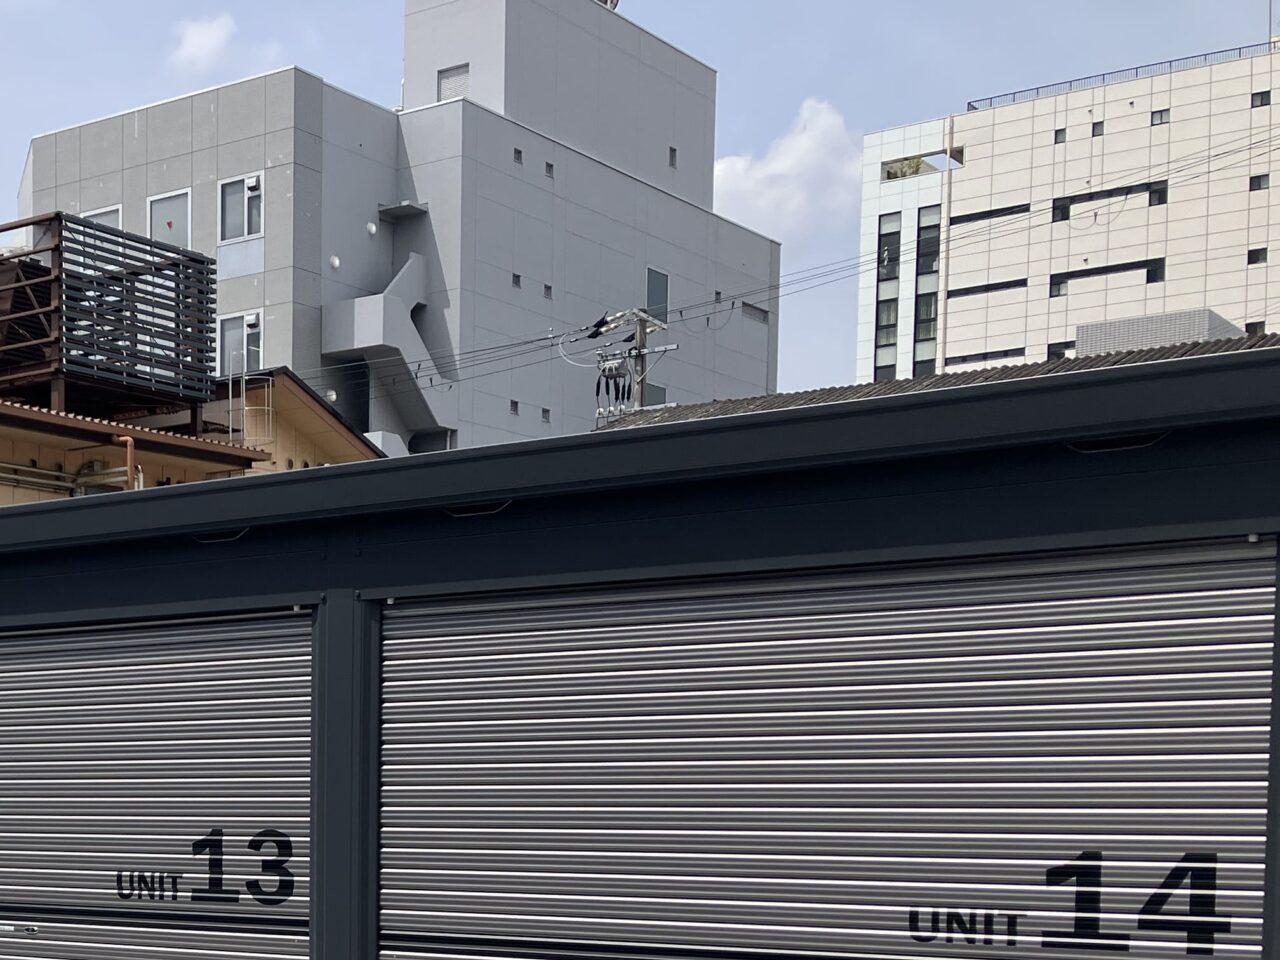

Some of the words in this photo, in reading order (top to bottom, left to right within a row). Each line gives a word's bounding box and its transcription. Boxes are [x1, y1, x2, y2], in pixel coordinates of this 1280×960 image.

[116, 871, 184, 901] UNIT
[190, 828, 296, 906] 13
[908, 906, 1028, 947] UNIT
[1040, 849, 1232, 957] 14
